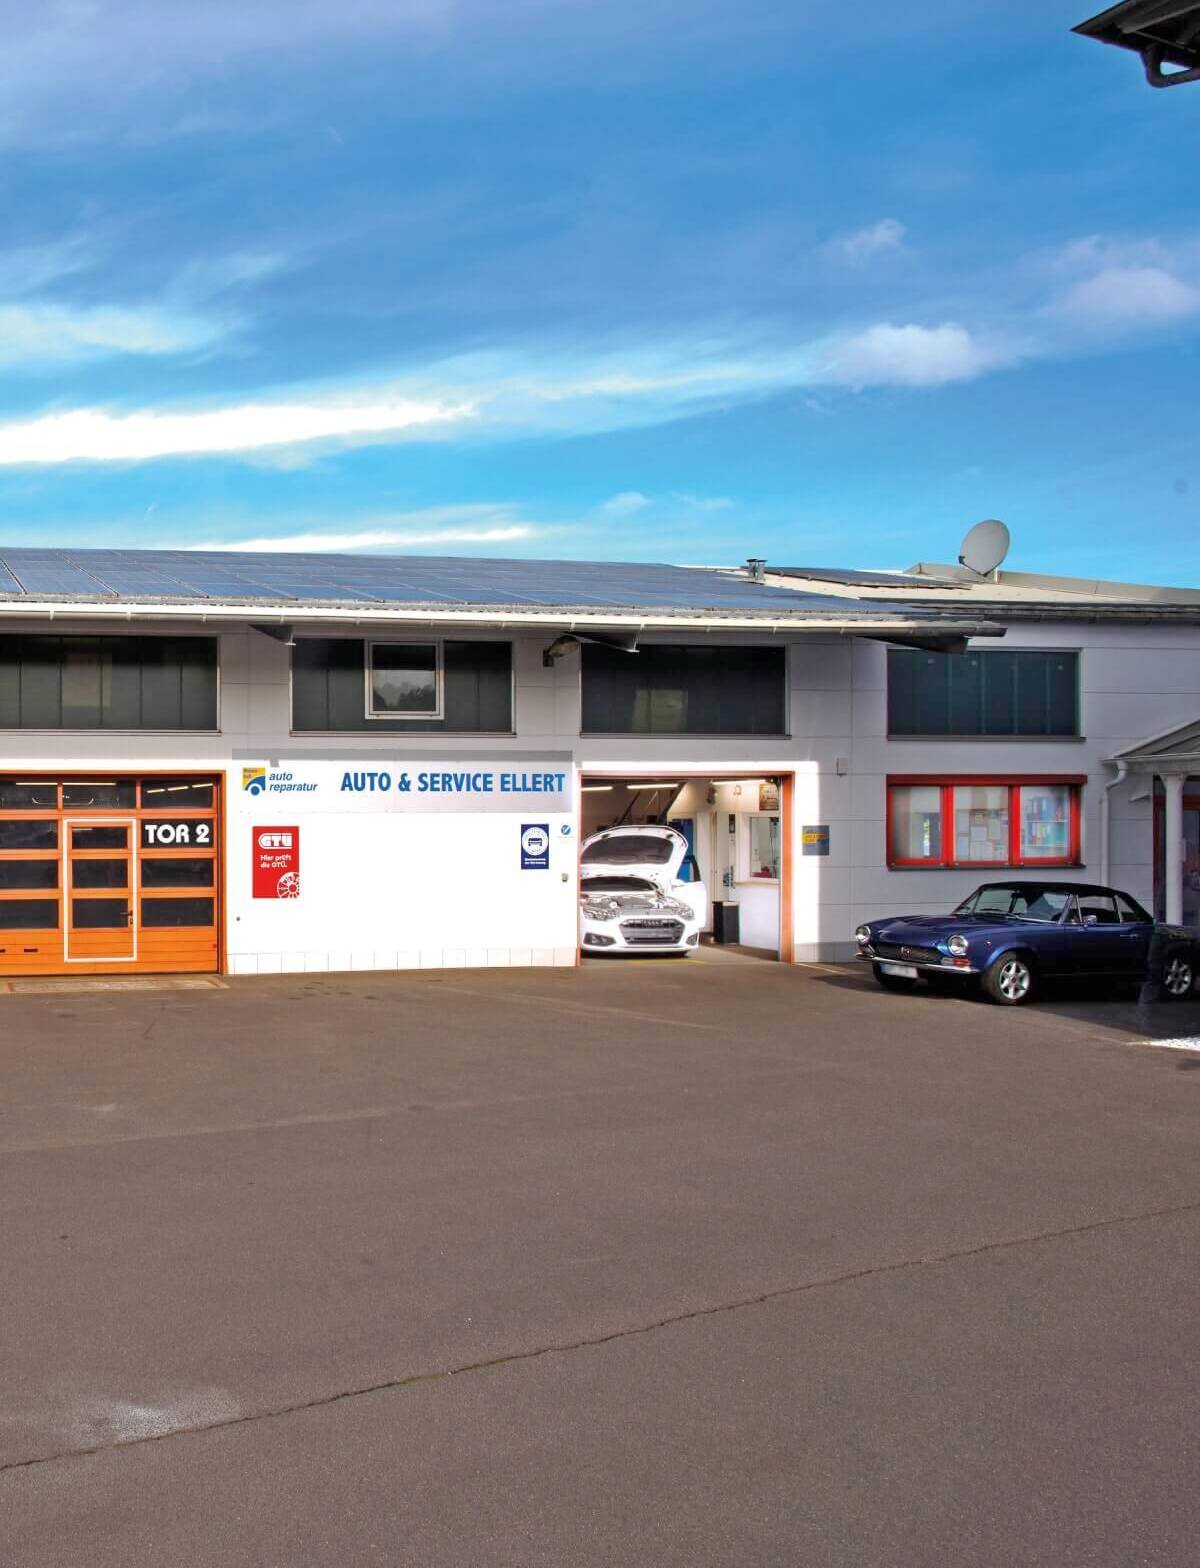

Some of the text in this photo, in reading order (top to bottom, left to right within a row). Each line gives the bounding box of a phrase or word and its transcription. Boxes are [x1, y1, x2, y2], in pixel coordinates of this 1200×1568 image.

[269, 772, 293, 781] auto
[340, 772, 566, 793] AUTO & SERVICE ELLERT
[269, 782, 318, 793] reparatur
[144, 824, 210, 844] TOR 2
